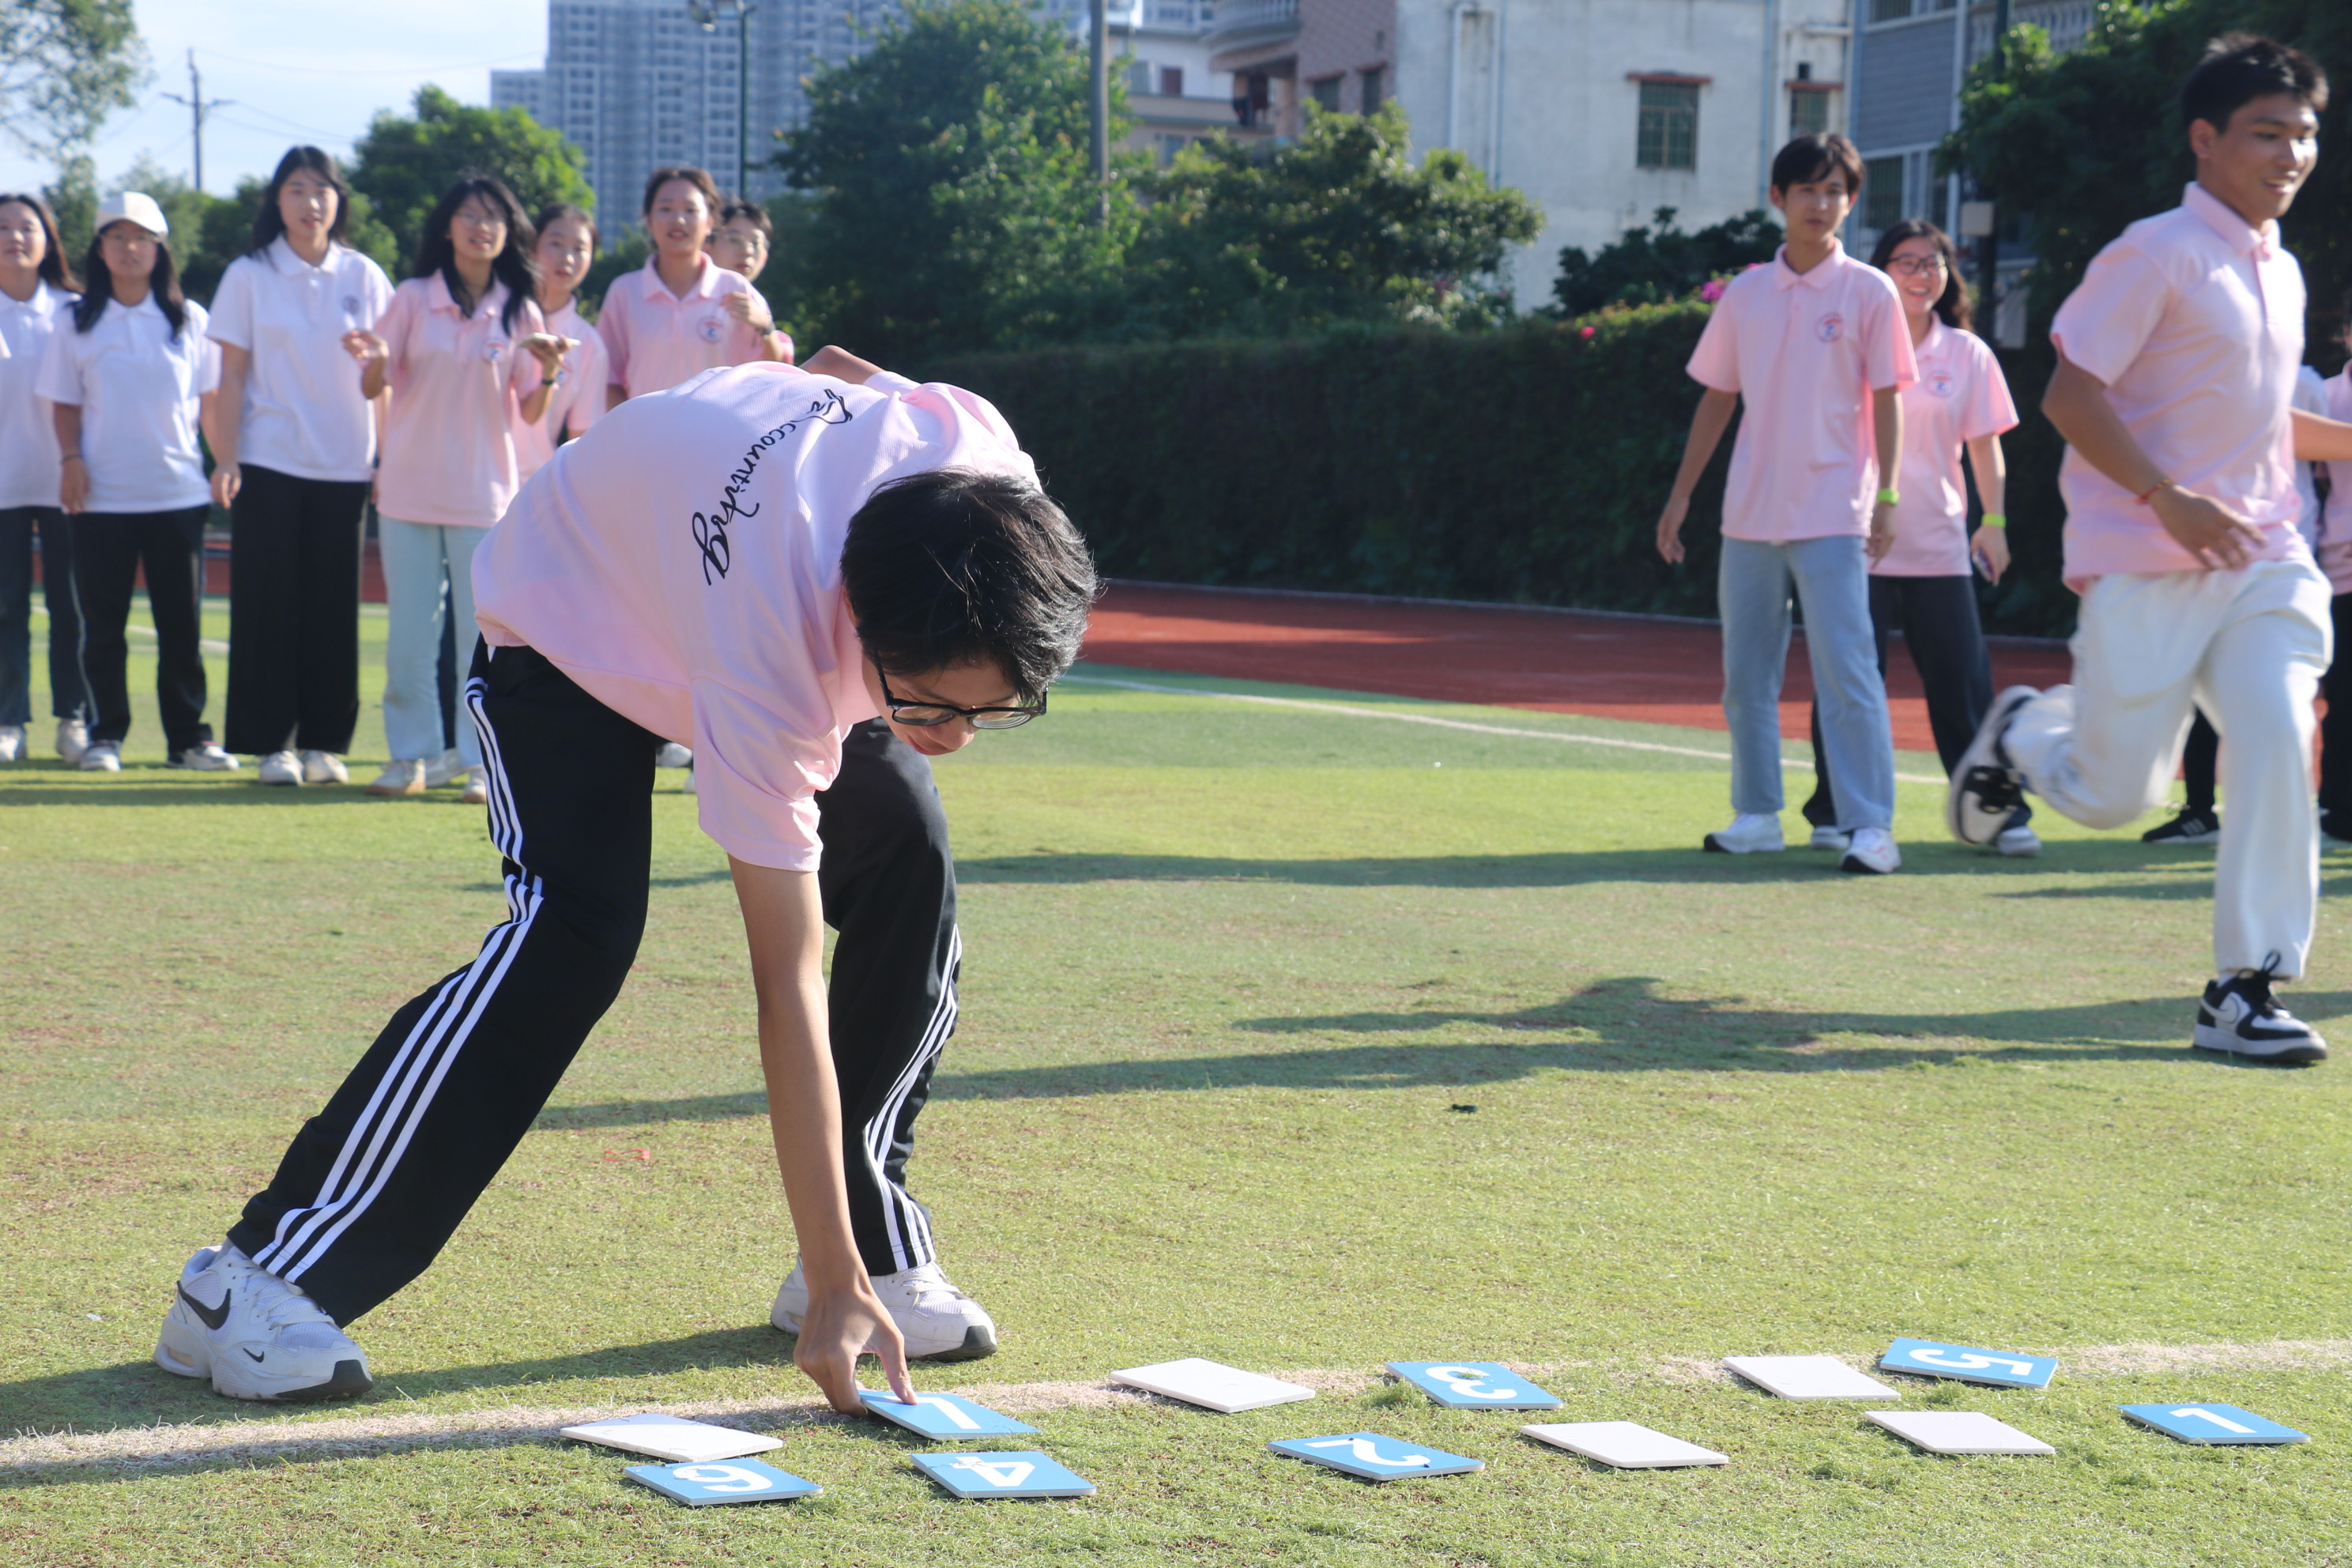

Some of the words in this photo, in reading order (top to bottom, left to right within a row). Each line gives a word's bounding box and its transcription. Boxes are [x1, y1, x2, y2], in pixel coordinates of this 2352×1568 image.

[1909, 1348, 2034, 1377] 5
[1425, 1365, 1517, 1400] 3
[2169, 1407, 2257, 1434] 1
[1304, 1438, 1431, 1467] 2
[948, 1456, 1036, 1487] 4
